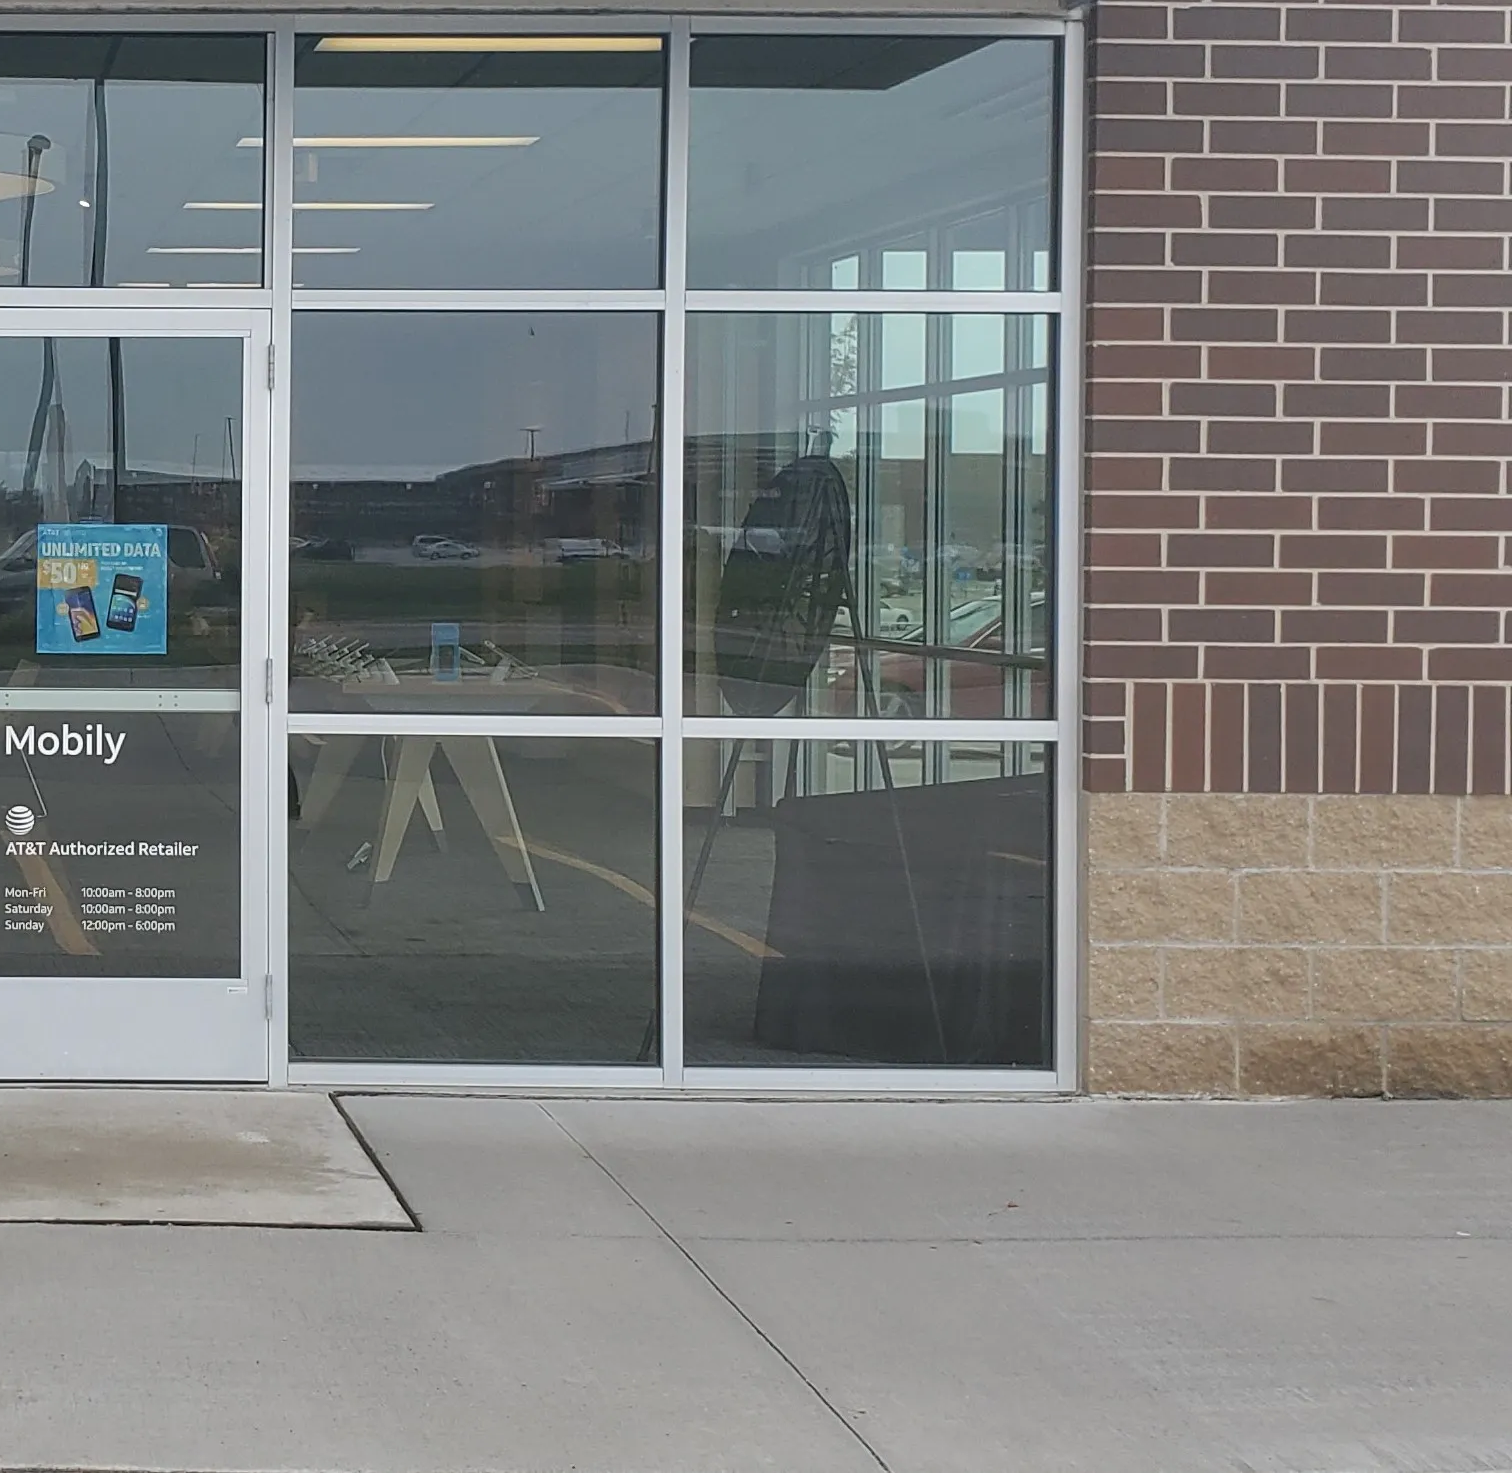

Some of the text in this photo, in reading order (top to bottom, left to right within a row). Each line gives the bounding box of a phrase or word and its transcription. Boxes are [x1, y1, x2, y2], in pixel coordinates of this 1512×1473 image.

[41, 542, 162, 558] UNLIMITED DATA
[42, 560, 77, 584] $50
[5, 724, 126, 765] Mobily
[5, 841, 199, 856] AT&T Authorized Retailer
[5, 887, 47, 898] Mon-Fri
[81, 888, 126, 898] 10:00am
[135, 888, 176, 901] 8:00pm
[5, 903, 54, 916] Saturday
[81, 904, 126, 914] 10:00am
[135, 904, 176, 917] 8:00pm
[5, 919, 45, 933] Sunday
[81, 920, 126, 933] 12:00pm
[135, 920, 176, 933] 6:00pm
